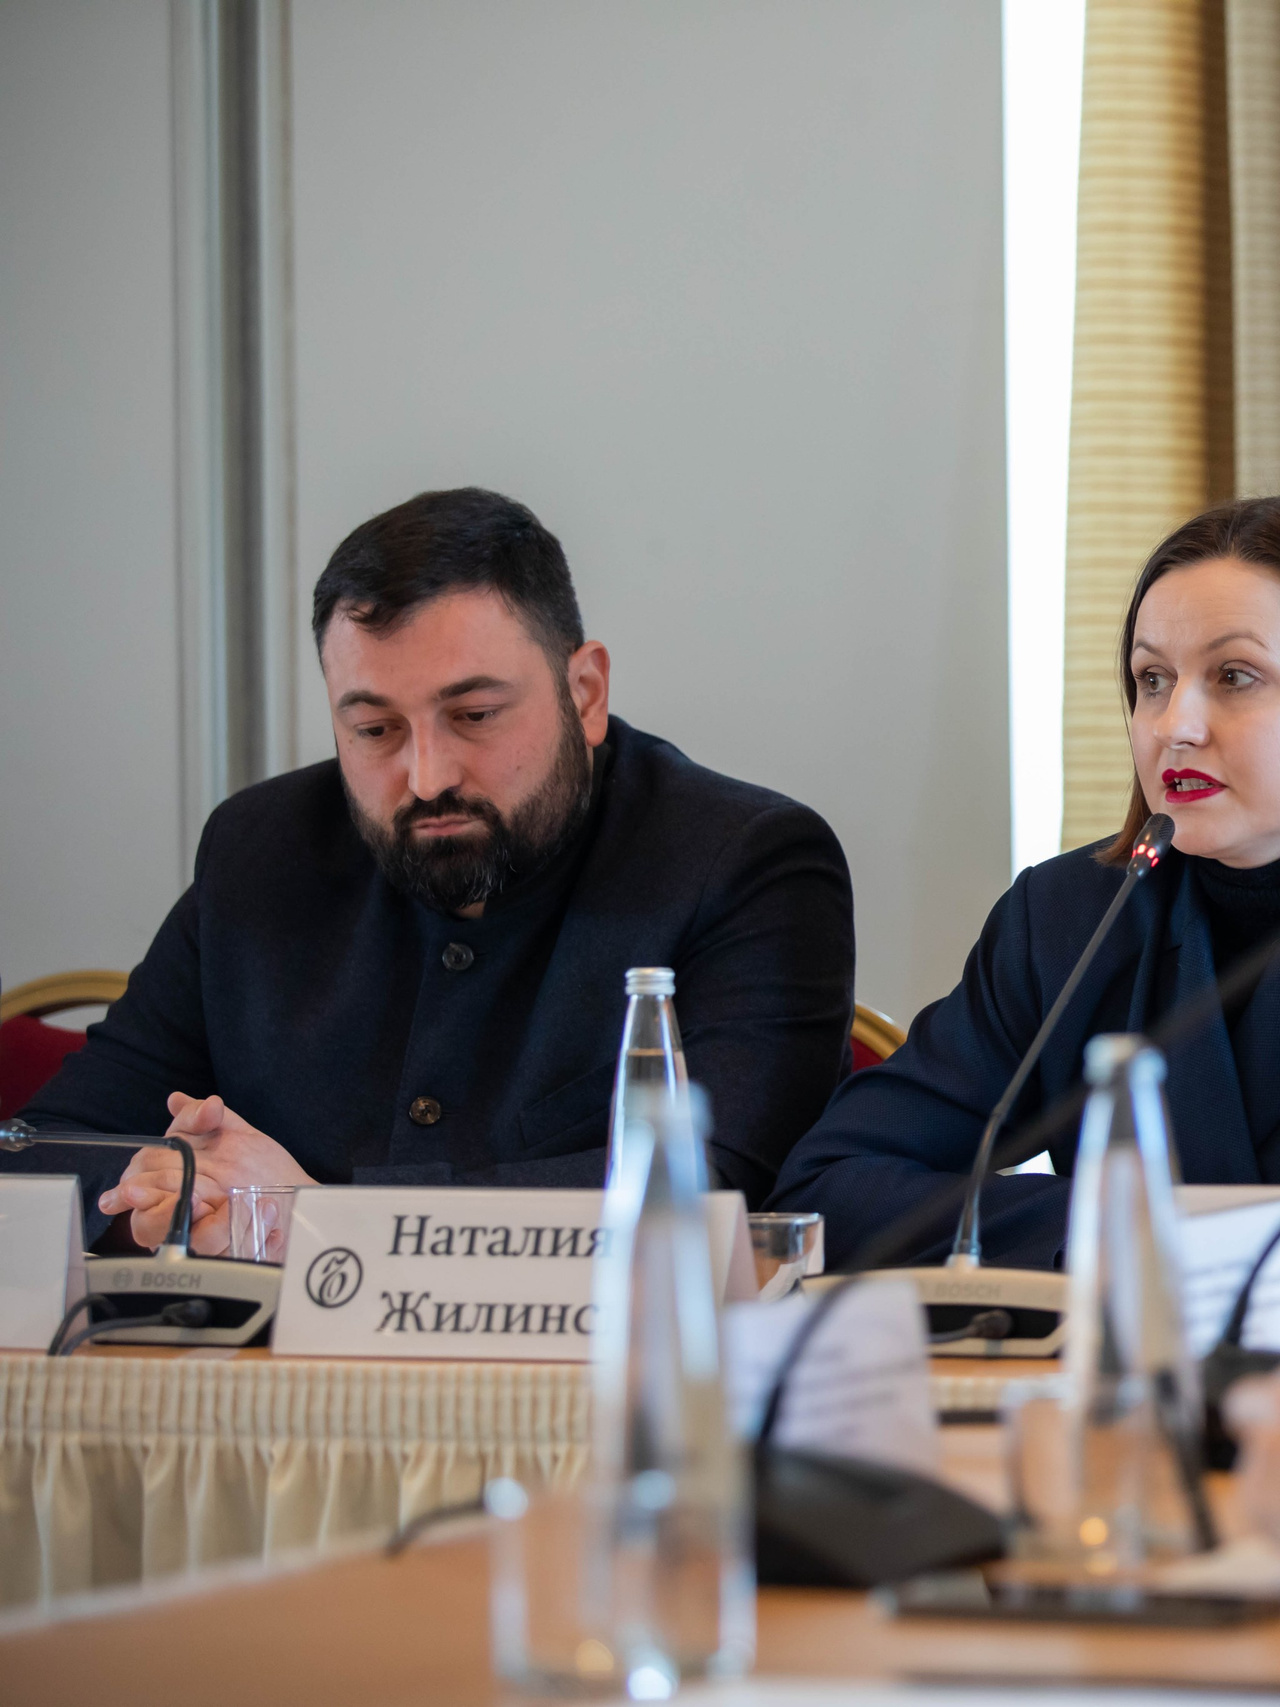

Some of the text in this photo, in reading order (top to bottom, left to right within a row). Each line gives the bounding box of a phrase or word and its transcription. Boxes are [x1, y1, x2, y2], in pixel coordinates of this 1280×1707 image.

[387, 1214, 615, 1258] Наталия
[140, 1271, 202, 1288] BOSCH
[375, 1291, 601, 1335] Жилинс
